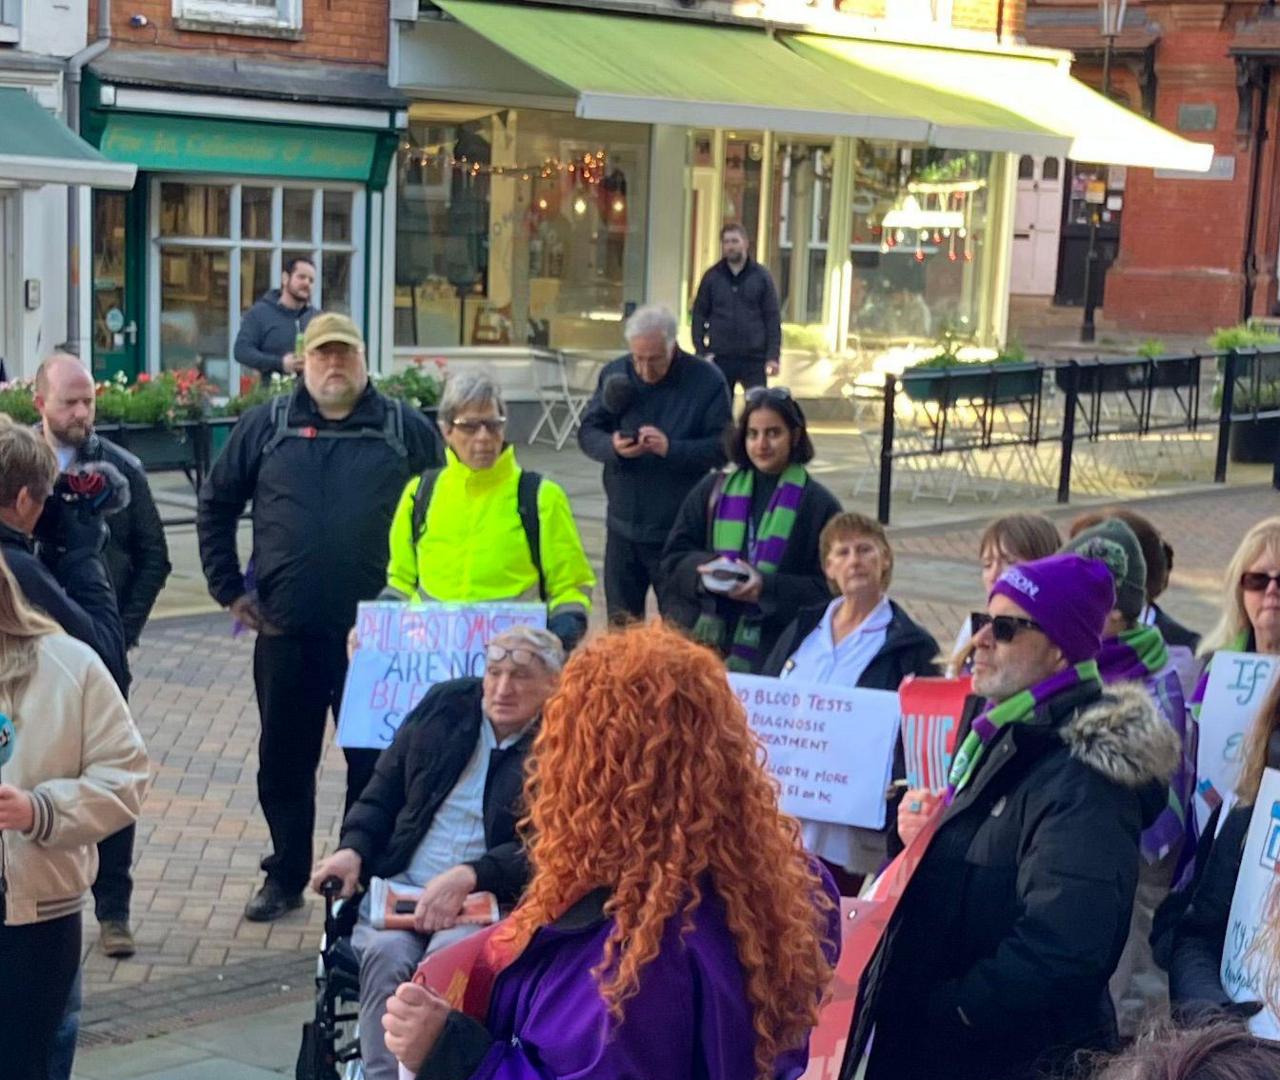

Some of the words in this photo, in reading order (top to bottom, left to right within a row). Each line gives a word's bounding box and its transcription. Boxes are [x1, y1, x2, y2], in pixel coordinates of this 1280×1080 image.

[384, 651, 439, 684] ARE
[1227, 659, 1271, 705] If
[755, 689, 801, 708] BLOOD
[807, 694, 854, 713] TESTS
[752, 713, 827, 733] DIAGNOSIS
[814, 769, 849, 785] MORE
